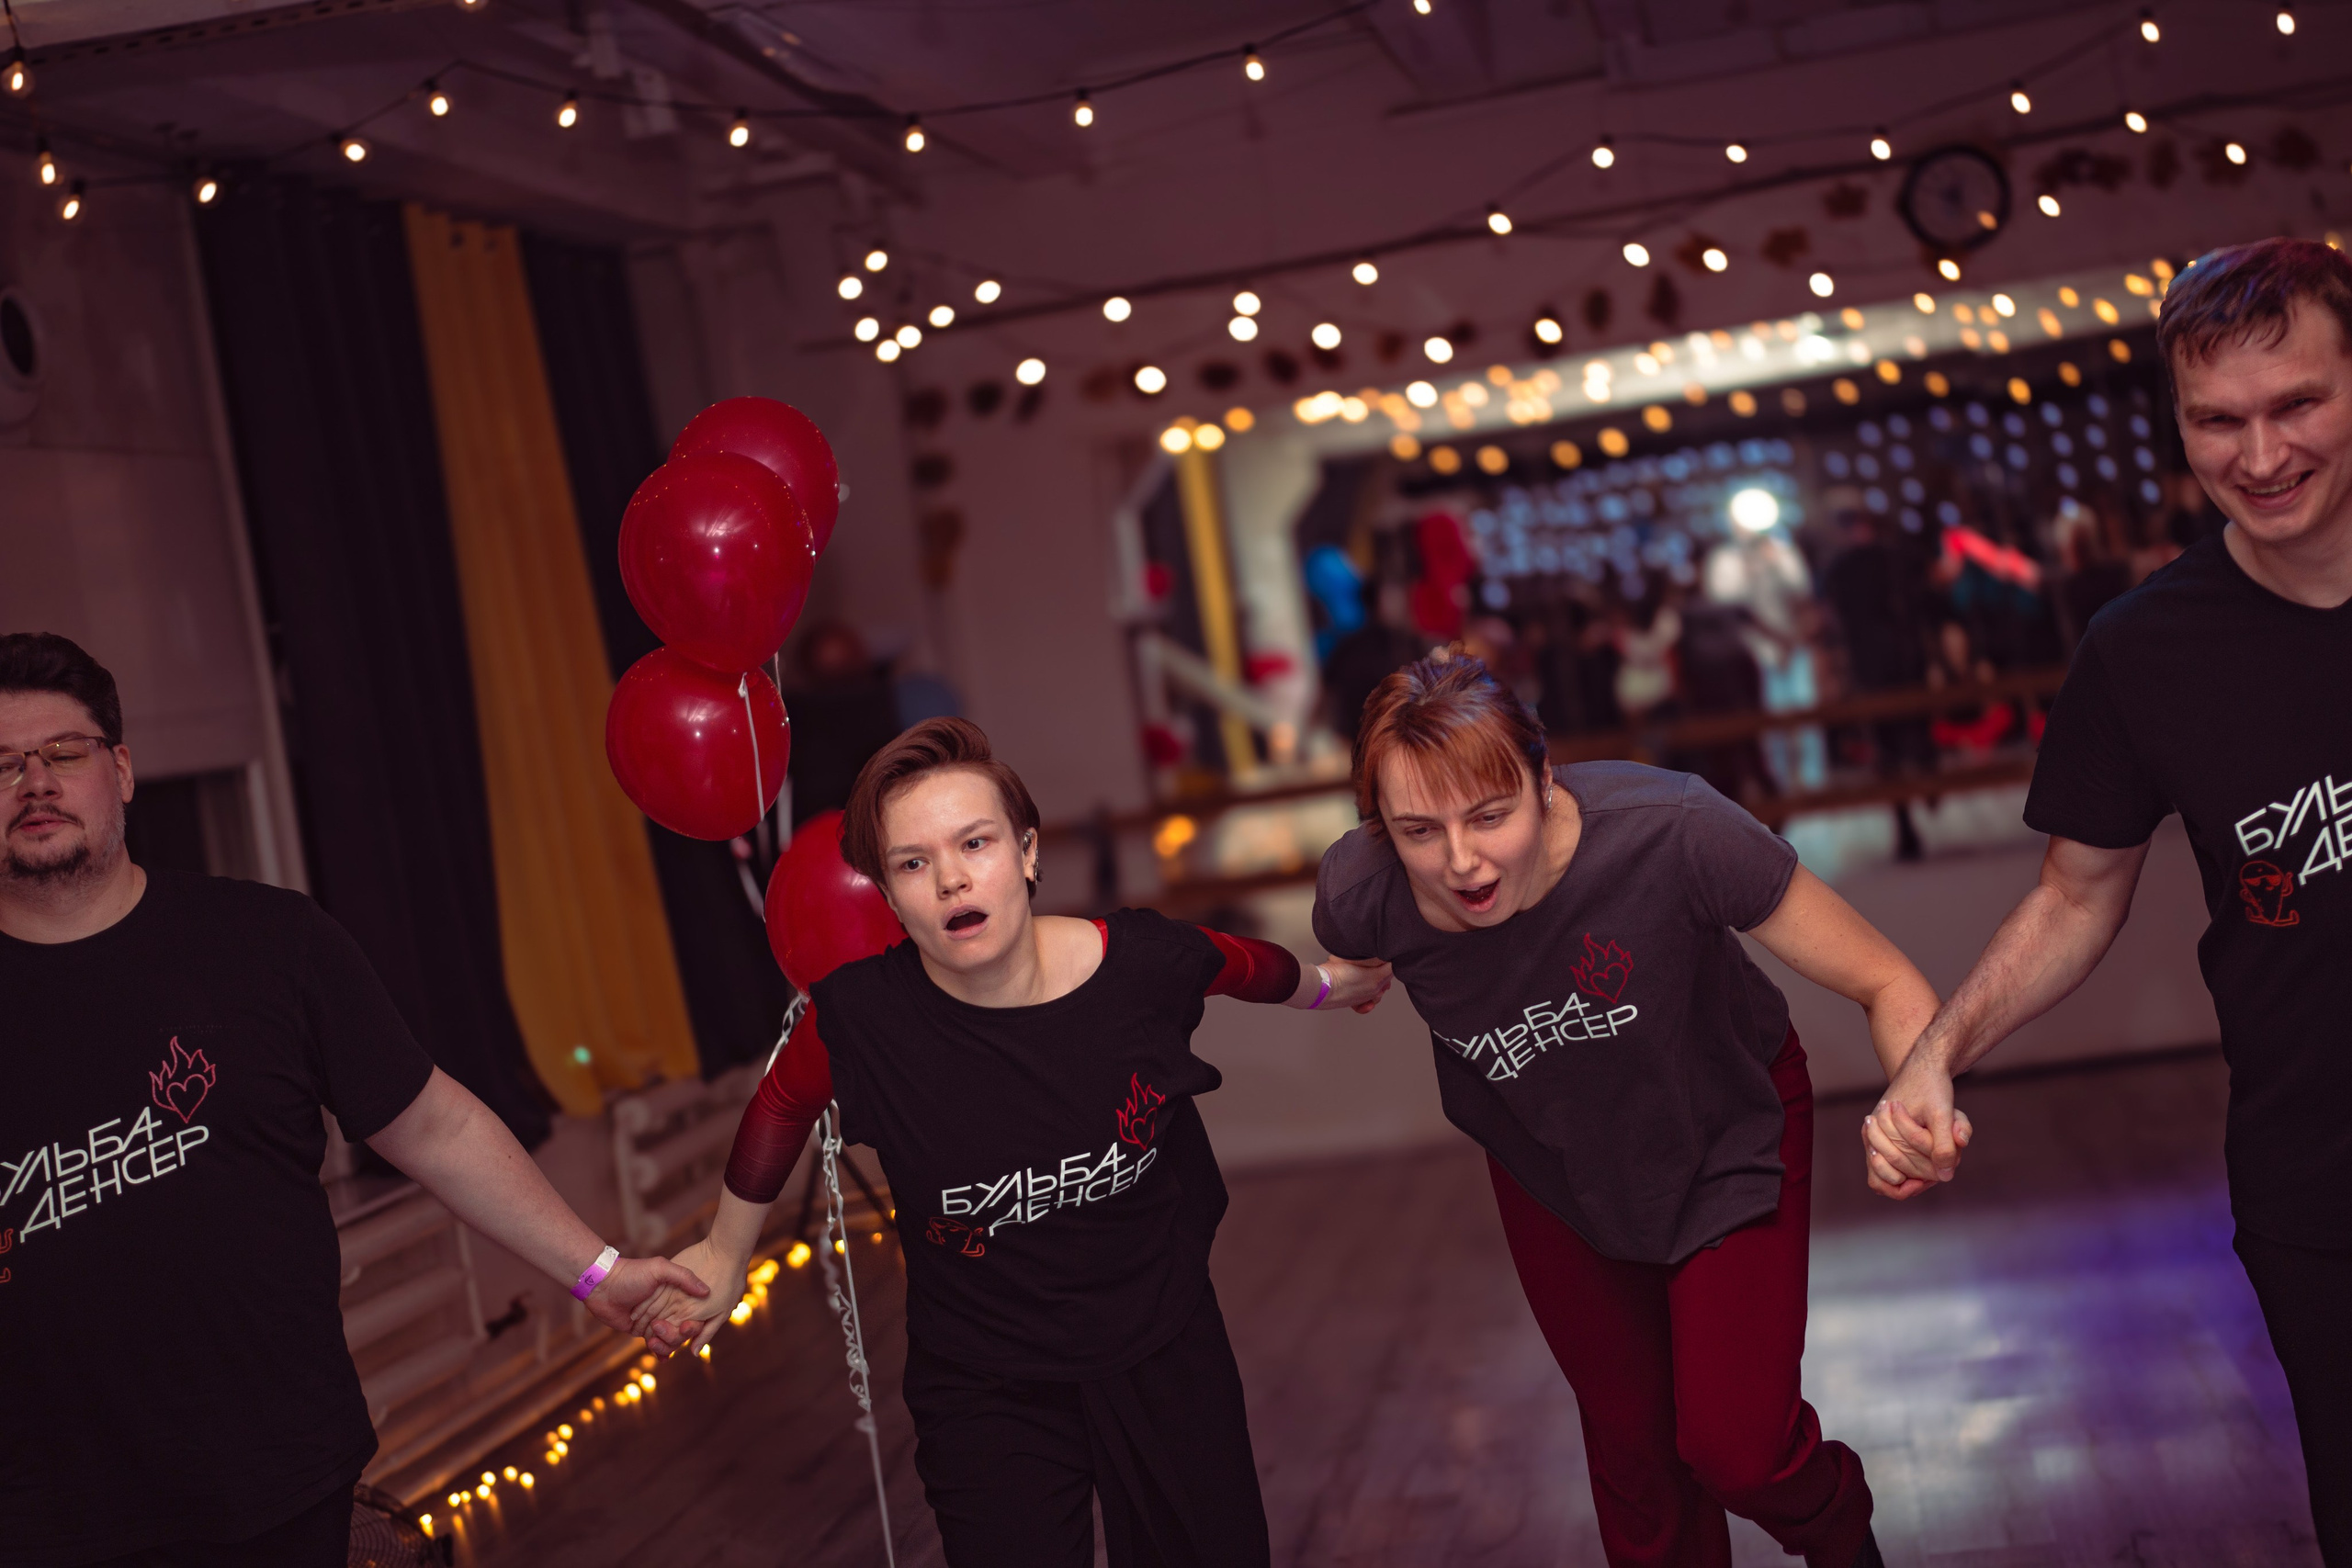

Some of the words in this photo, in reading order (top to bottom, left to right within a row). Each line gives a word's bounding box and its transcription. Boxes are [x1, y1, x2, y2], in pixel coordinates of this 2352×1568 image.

[1486, 1004, 1638, 1081] ДЕНСЕР
[20, 1125, 209, 1244] ДЕНСЕР
[942, 1142, 1127, 1215] БУЛЬБА
[989, 1147, 1158, 1237] ДЕНСЕР
